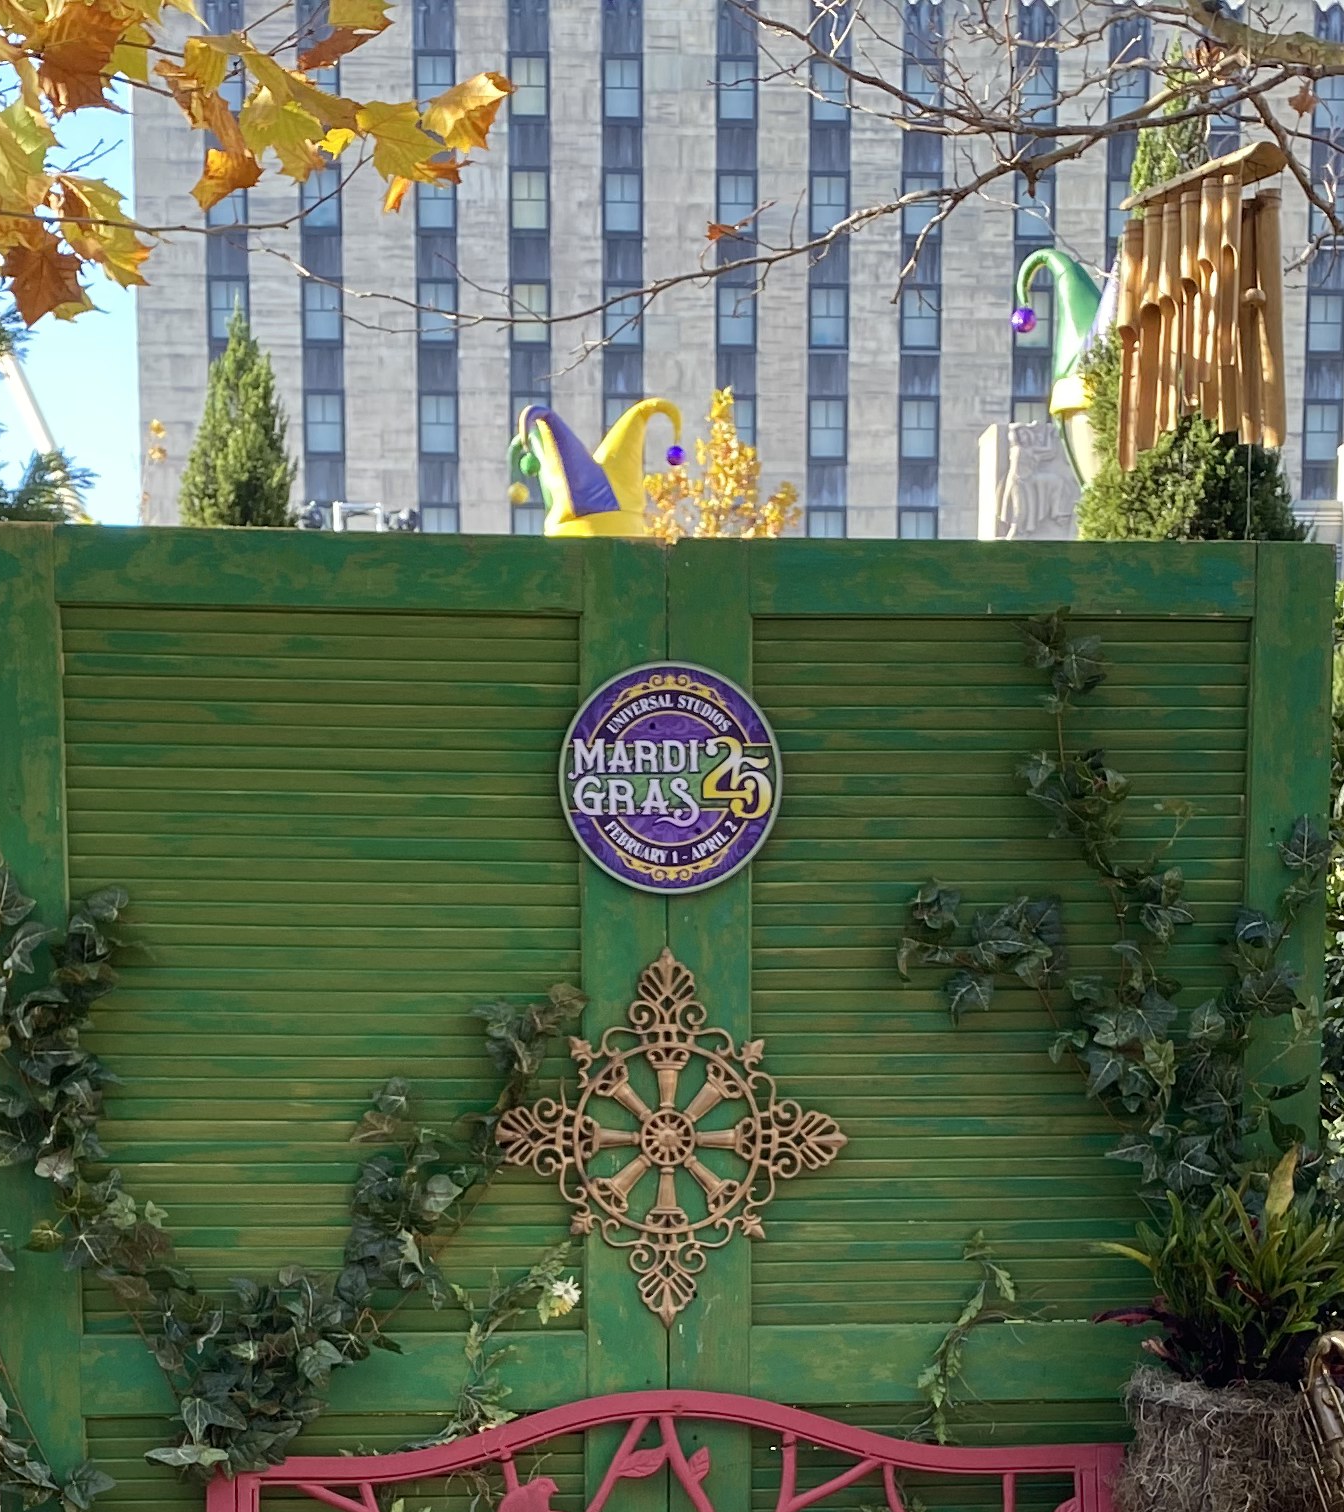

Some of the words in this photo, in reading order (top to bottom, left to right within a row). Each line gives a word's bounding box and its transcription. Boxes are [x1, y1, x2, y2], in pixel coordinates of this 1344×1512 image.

[605, 693, 674, 734] UNIVERSAL
[677, 694, 732, 733] STUDIOS
[568, 738, 700, 780] MARDI
[702, 736, 773, 819] 25
[573, 775, 700, 827] GRAS
[603, 820, 668, 864] FEBRUARY
[670, 851, 679, 864] 1
[691, 831, 729, 860] APRIL
[725, 820, 738, 833] 2
